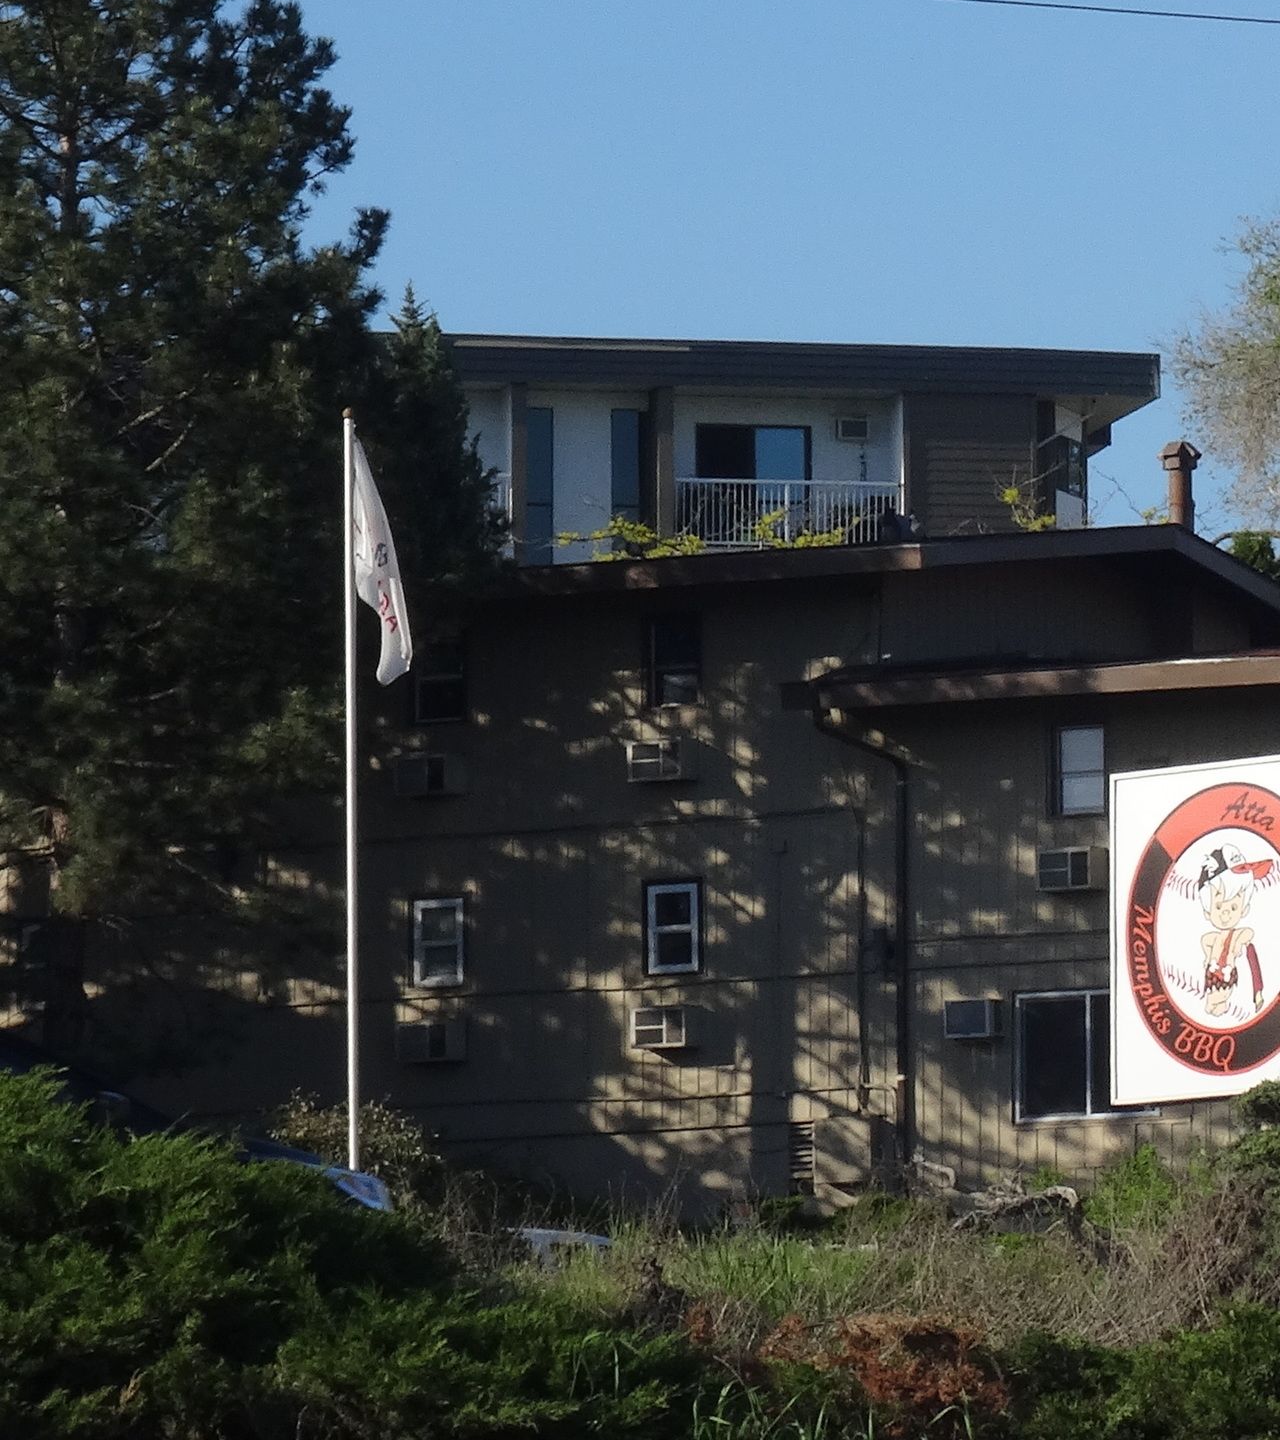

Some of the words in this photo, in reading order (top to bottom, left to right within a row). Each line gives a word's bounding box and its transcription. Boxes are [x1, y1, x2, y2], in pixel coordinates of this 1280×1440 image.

[1221, 792, 1275, 831] Atta
[1131, 904, 1172, 1034] Memphis
[1174, 1021, 1236, 1072] BBQ
